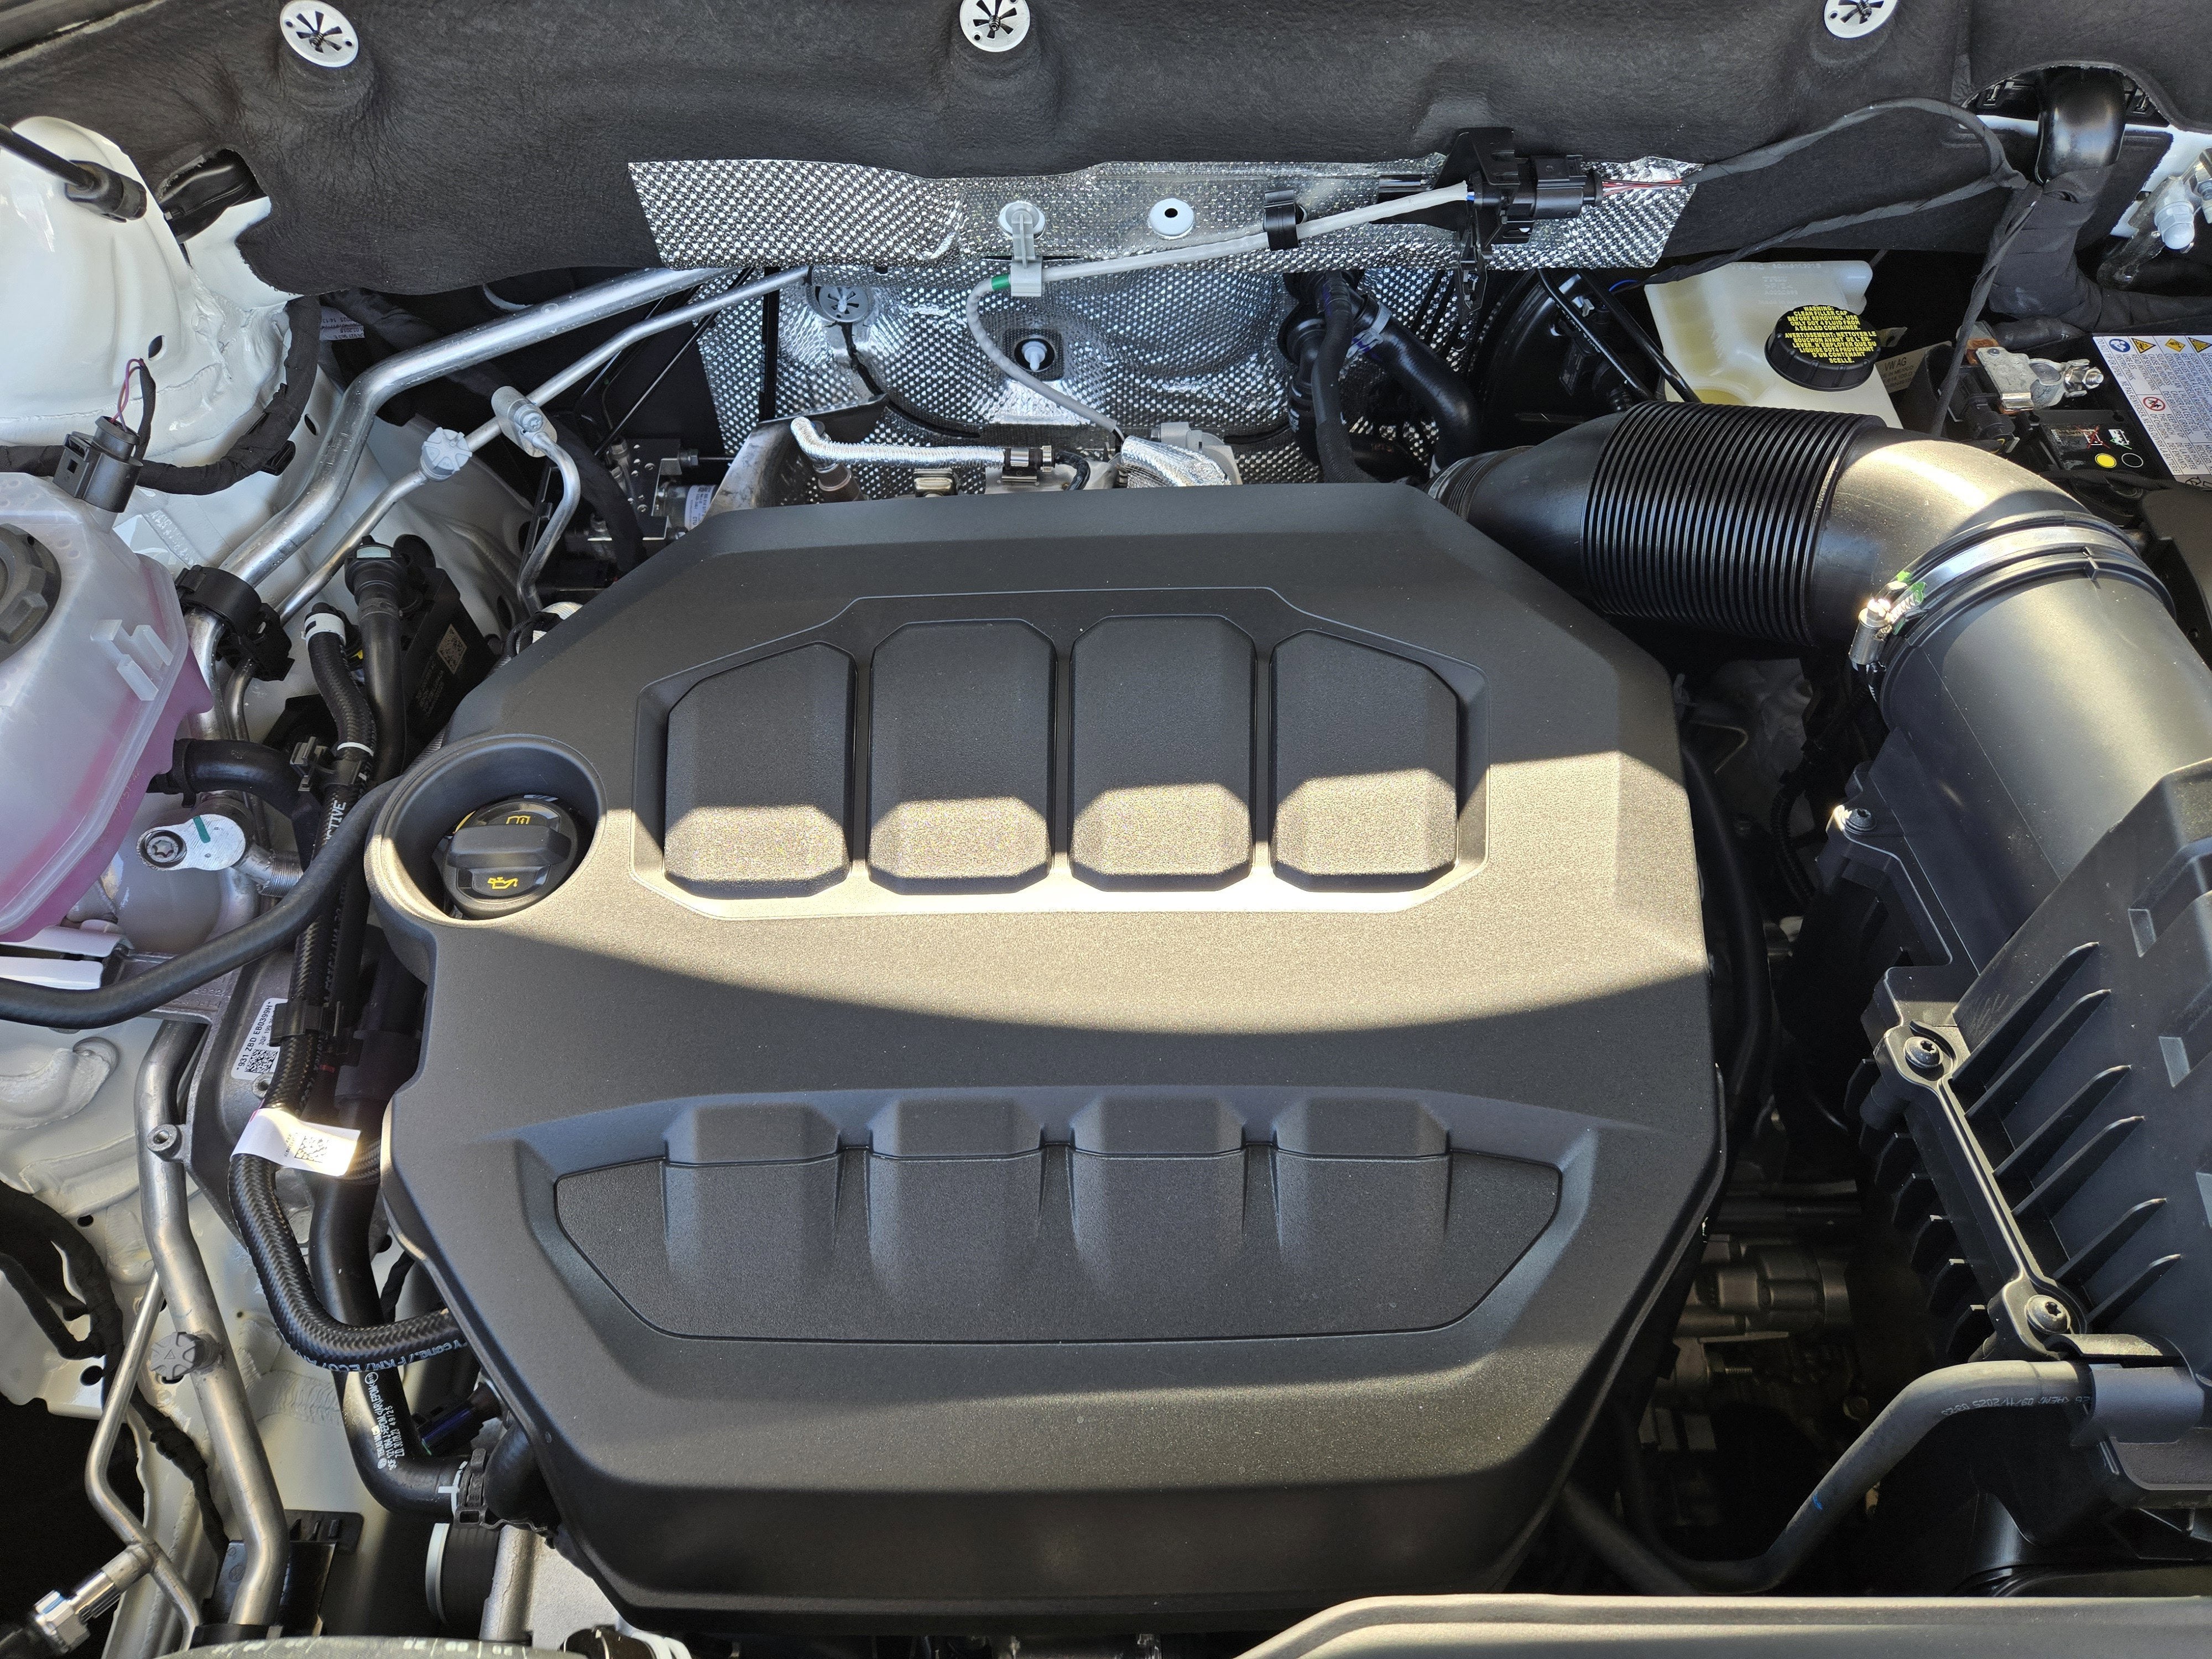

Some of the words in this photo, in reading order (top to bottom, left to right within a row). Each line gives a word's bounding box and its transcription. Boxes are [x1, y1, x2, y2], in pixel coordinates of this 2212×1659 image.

[1897, 357, 1907, 366] AG
[2130, 354, 2142, 364] READ
[2142, 360, 2157, 373] SEVERE
[2154, 353, 2172, 371] SULFURIC
[2163, 353, 2183, 374] CONSULTEZ
[2187, 353, 2200, 364] FLUSH
[2195, 365, 2207, 374] EYES
[2147, 354, 2160, 365] CAUSE
[2154, 367, 2173, 385] BLINDNESS
[2184, 361, 2200, 375] MEDICAL
[2194, 377, 2206, 386] HELP
[2169, 391, 2185, 405] CAUSER
[2177, 390, 2193, 405] L'ACIDE
[2185, 406, 2209, 430] SULFURIQUE
[2165, 414, 2177, 424] KEEP
[2161, 422, 2176, 435] REACH
[2150, 432, 2166, 447] OUVRIR
[2183, 442, 2196, 453] TENIR
[2190, 454, 2203, 465] HORS
[324, 799, 346, 842] CTIVE
[245, 1037, 256, 1052] ZBD
[258, 1035, 267, 1045] 3QF
